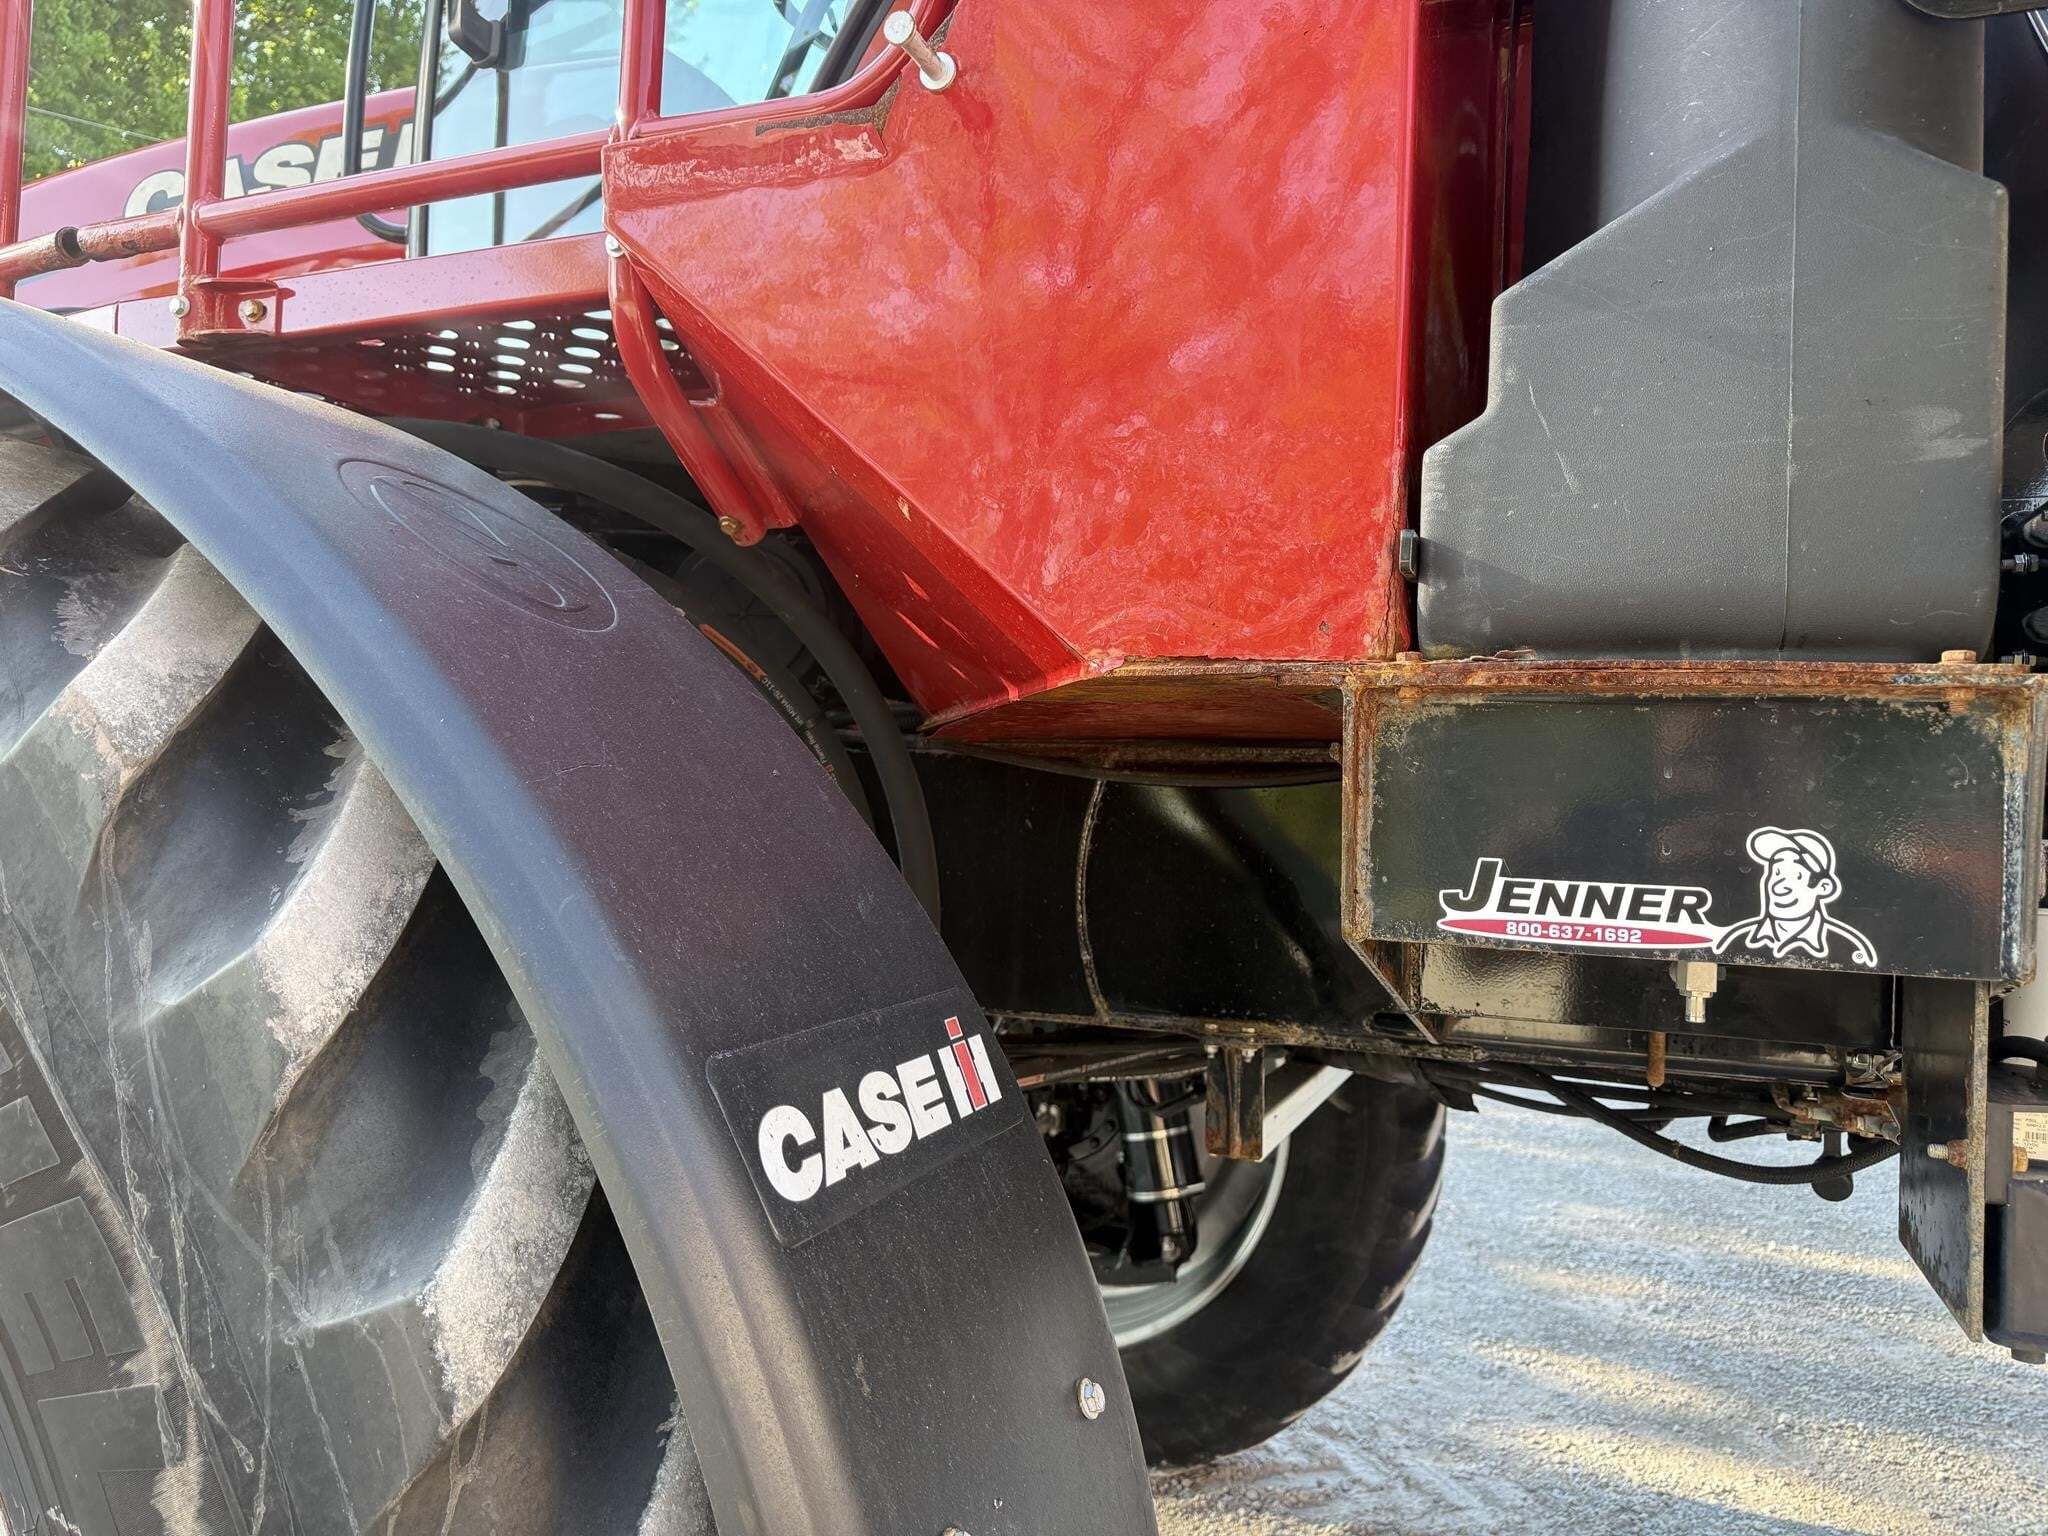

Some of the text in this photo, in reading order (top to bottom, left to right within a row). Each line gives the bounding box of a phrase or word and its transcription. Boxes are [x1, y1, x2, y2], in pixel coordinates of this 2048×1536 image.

[1442, 858, 1711, 924] JENNER
[1505, 920, 1643, 944] 800-637-1692
[758, 1054, 953, 1202] CASE
